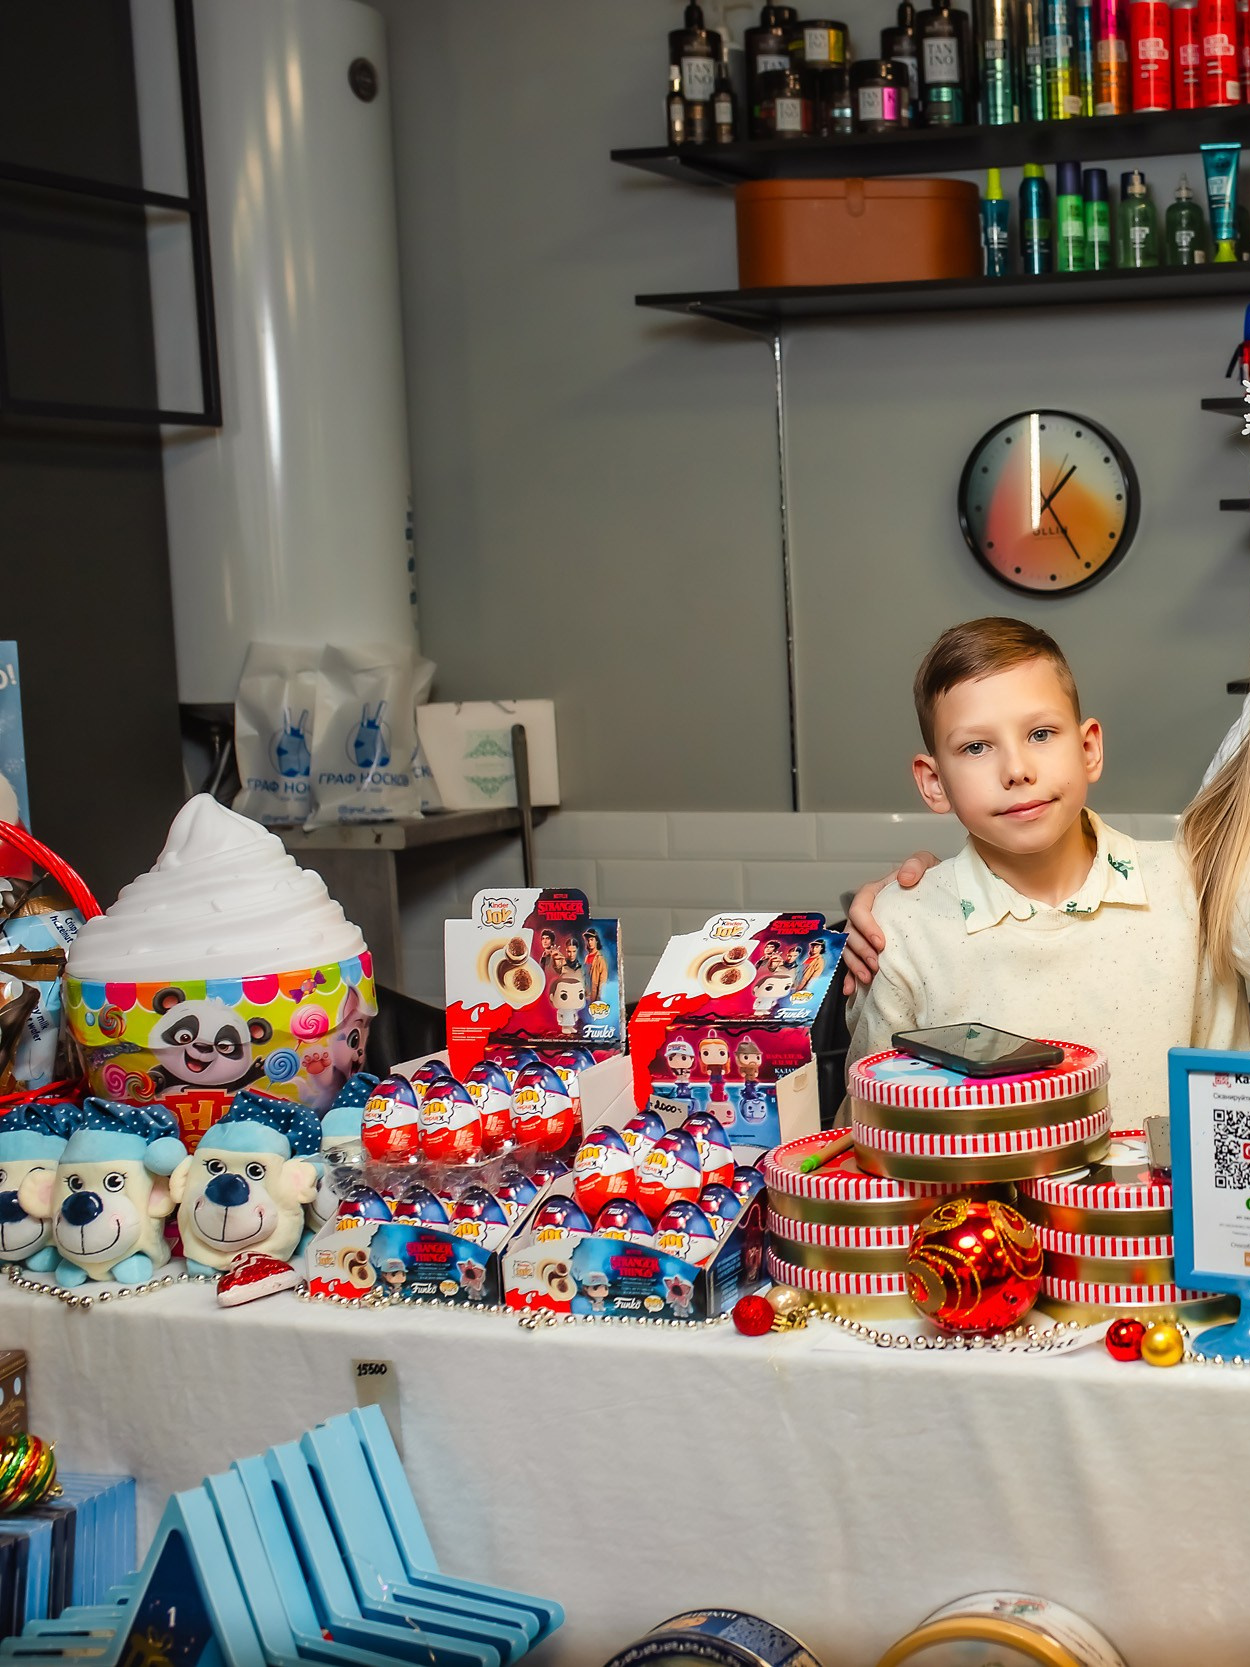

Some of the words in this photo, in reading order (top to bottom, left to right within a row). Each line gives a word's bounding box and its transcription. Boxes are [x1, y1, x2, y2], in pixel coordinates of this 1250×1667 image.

[247, 778, 279, 793] ГРАФ
[318, 773, 356, 785] ГРАФ
[537, 900, 585, 915] STRANGER
[485, 908, 513, 925] JOY
[545, 912, 578, 921] THINGS
[65, 917, 78, 935] Crispy
[770, 920, 821, 931] STRANGER
[775, 1008, 812, 1019] Funko
[36, 1012, 50, 1031] milk
[28, 1020, 42, 1042] wafer
[582, 1025, 616, 1039] Funko
[406, 1242, 453, 1257] STRANGER
[415, 1254, 447, 1263] THINGS
[610, 1256, 660, 1271] STRANGER
[619, 1268, 653, 1277] THINGS
[411, 1283, 437, 1294] Funko
[614, 1297, 642, 1310] Funko
[167, 1606, 176, 1628] 1
